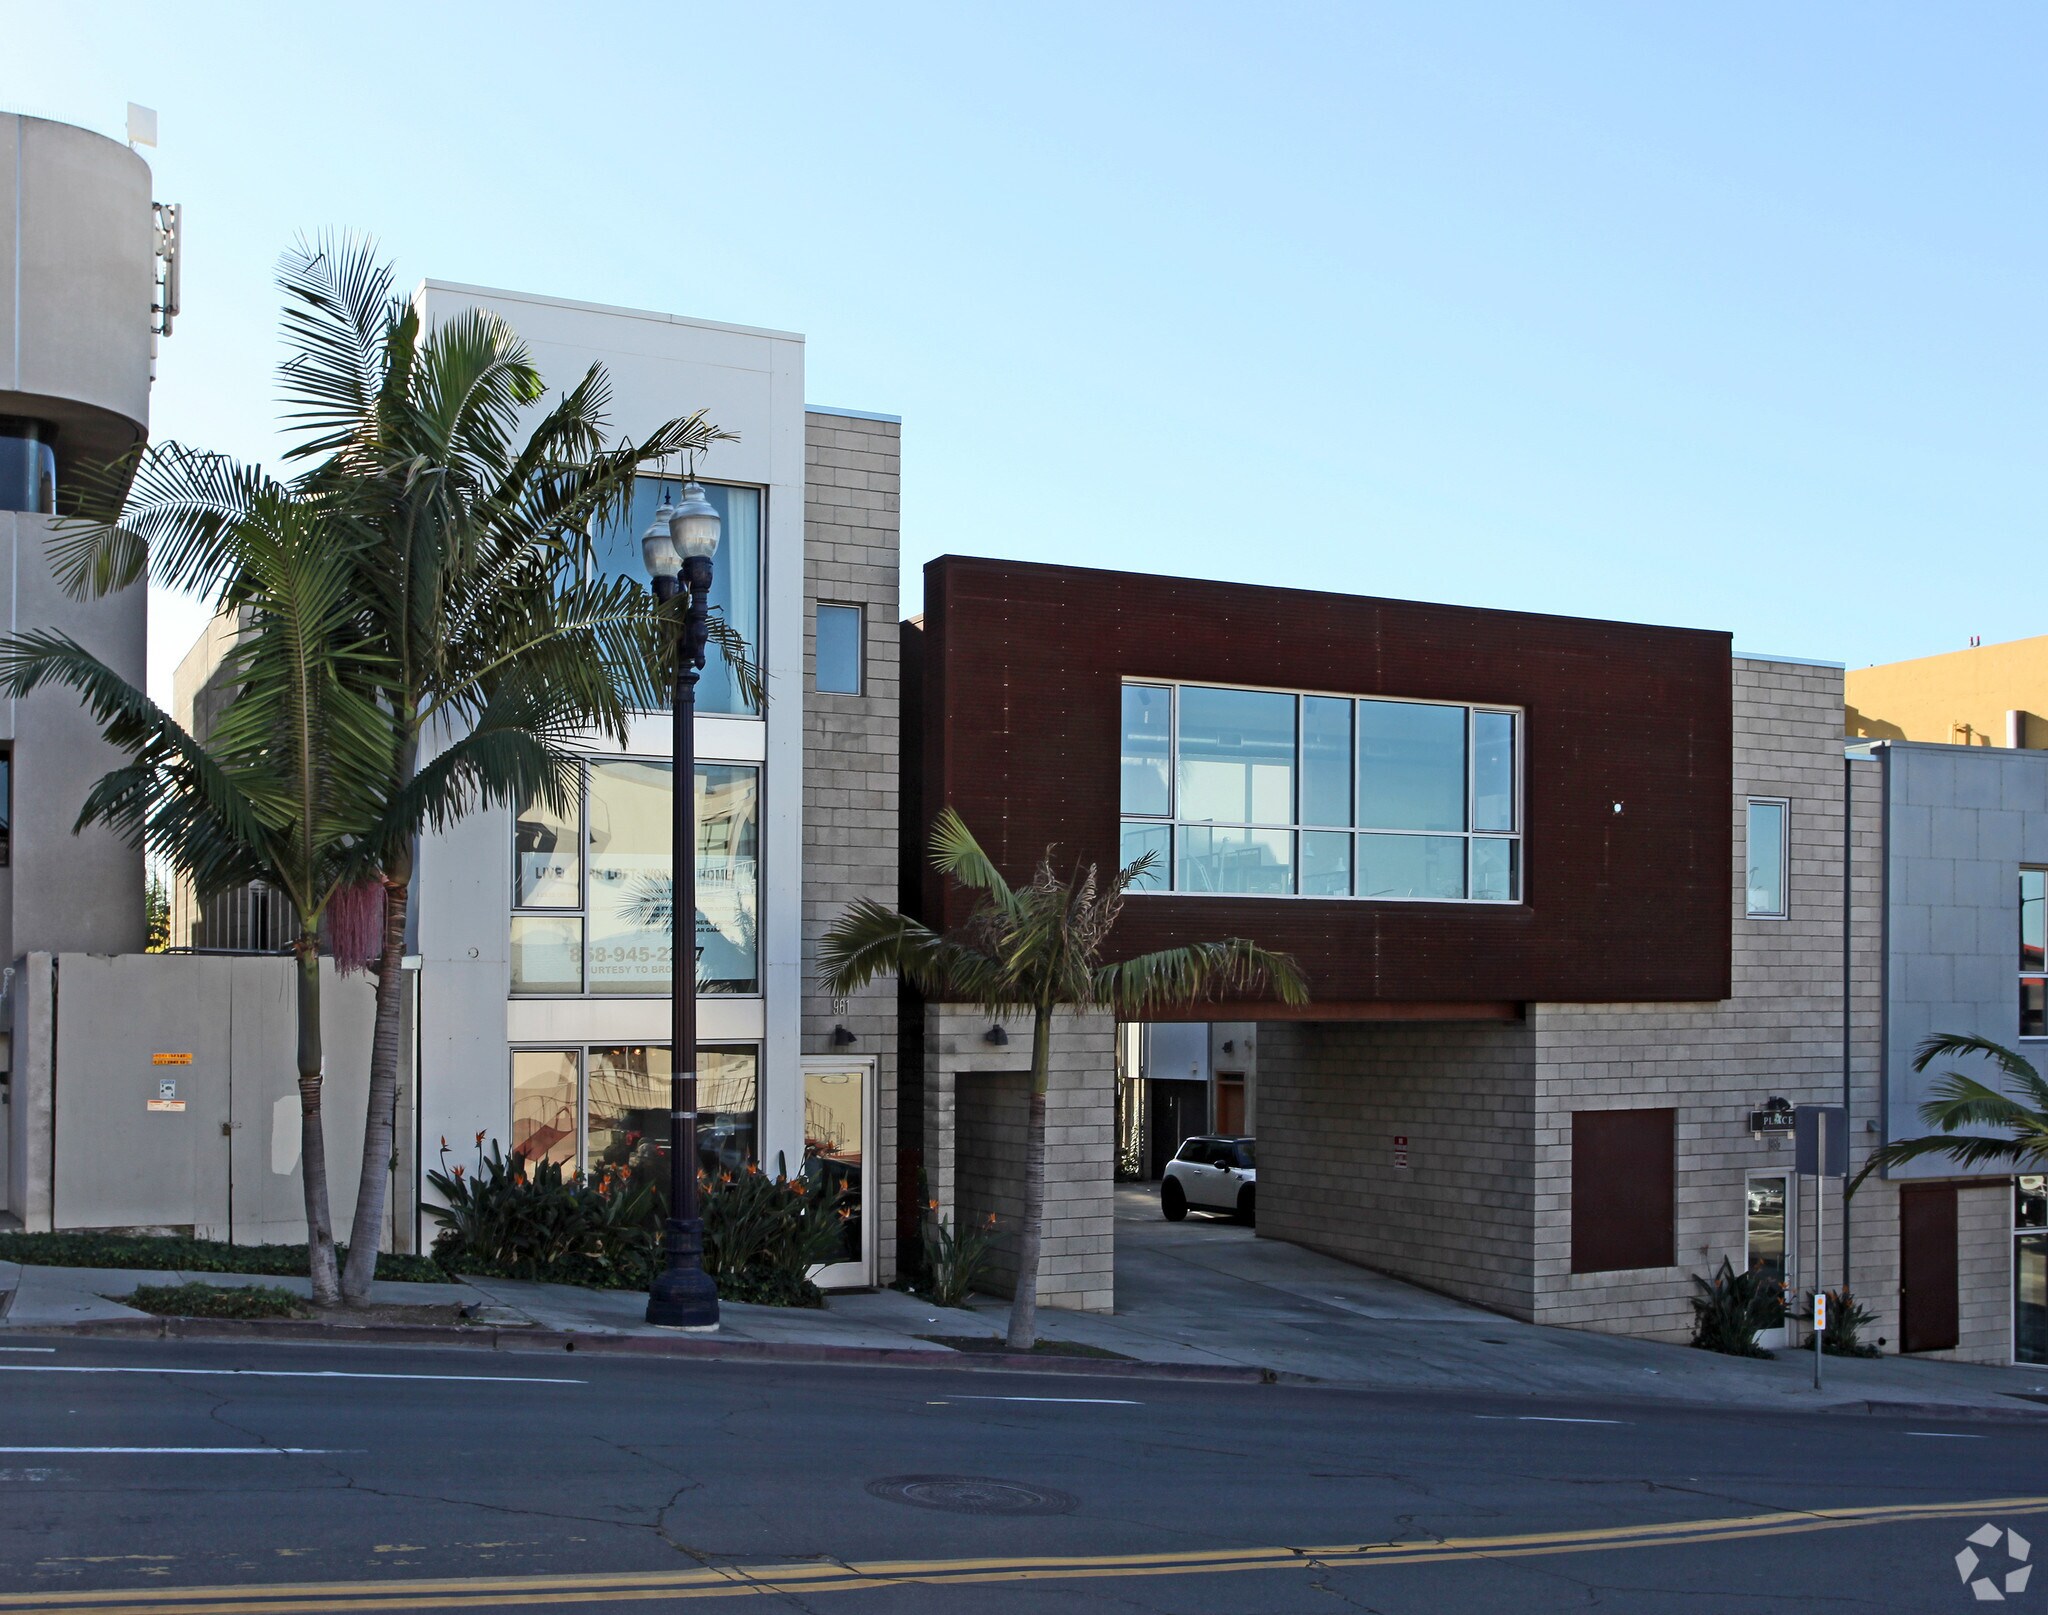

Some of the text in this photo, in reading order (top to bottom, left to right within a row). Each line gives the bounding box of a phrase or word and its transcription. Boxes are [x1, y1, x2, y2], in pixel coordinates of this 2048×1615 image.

[576, 965, 673, 974] CURTESY TO BRO
[833, 998, 850, 1015] 961
[1763, 1113, 1793, 1125] PLACE
